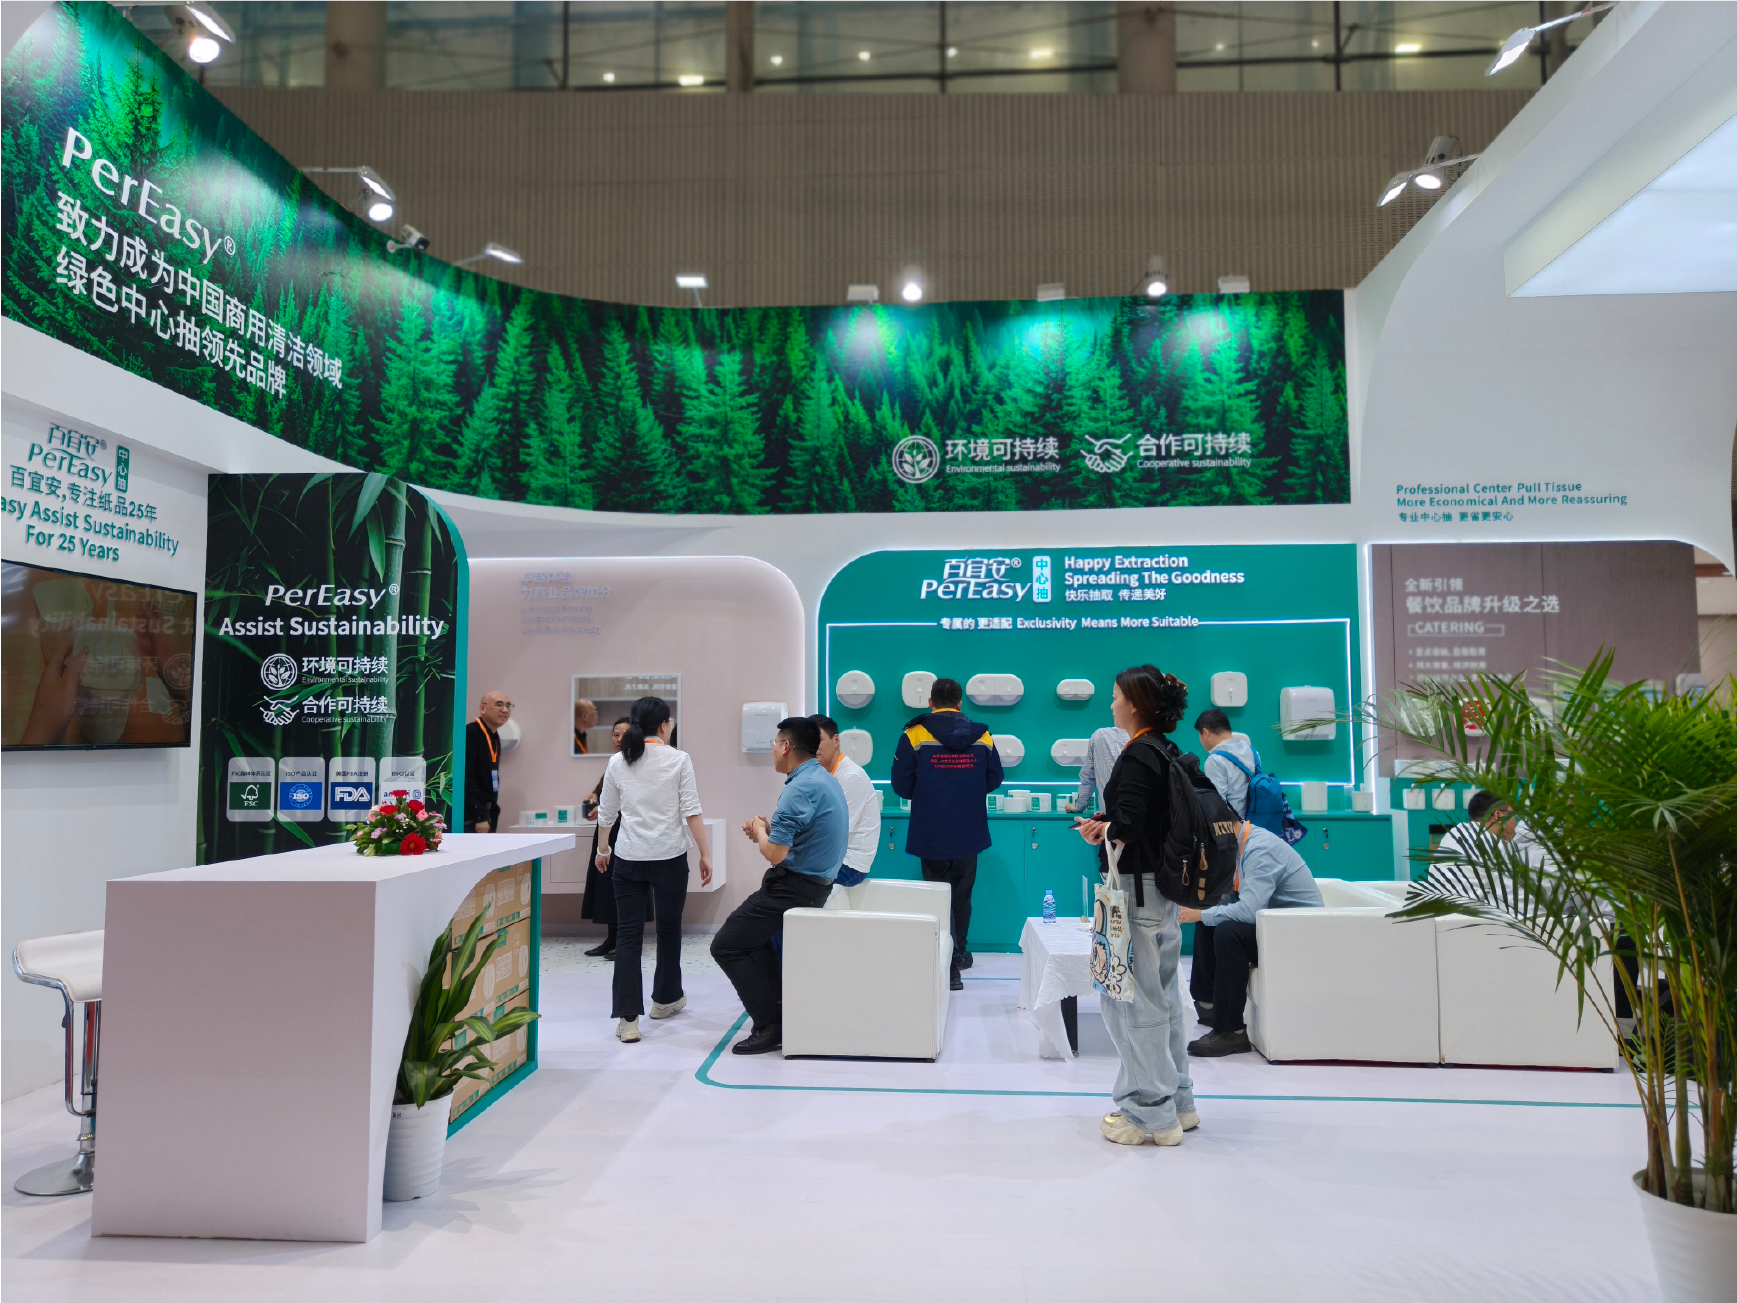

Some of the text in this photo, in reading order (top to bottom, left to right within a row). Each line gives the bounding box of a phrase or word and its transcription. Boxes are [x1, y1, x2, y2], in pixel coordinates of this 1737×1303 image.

[56, 191, 343, 390] 致力成为中国商用清洁领域
[56, 246, 287, 399] 绿色中心抽领先品牌
[945, 436, 1060, 461] 环境可持续
[1137, 432, 1251, 456] 合作可持续
[28, 442, 113, 486] PerEasy
[117, 448, 129, 491] 中心抽
[946, 462, 1061, 474] Environmental sustainability
[1137, 457, 1252, 470] Cooperative sustainability
[1396, 482, 1582, 495] Professional Center Pull Tissue
[1397, 493, 1628, 507] More Economical And More Reassuring
[1399, 511, 1514, 523] 专业中心抽 更省更安心
[31, 501, 79, 529] Assist
[84, 514, 180, 556] Sustainability
[26, 524, 119, 562] For 25 Years
[1065, 555, 1188, 572] Happy Extraction
[1035, 558, 1049, 600] 中心抽
[1065, 570, 1245, 588] Spreading The Goodness
[1404, 578, 1463, 592] 全新引领
[520, 586, 611, 599] 为商业品牌加分
[919, 578, 1032, 602] PerEasy
[1065, 588, 1166, 602] 快乐抽取 传递美好
[1406, 595, 1560, 614] 餐饮品牌升级之选
[219, 616, 284, 636] Assist
[290, 615, 444, 640] Sustainability
[940, 615, 1199, 631] 专属的 更适配 Exclusivity Means More Suitable
[1415, 622, 1485, 634] CATERING
[302, 656, 389, 675] 环境可持续
[302, 676, 389, 684] Environmental sustainability
[302, 696, 388, 714] 合作可持续
[302, 715, 388, 724] Cooperative sustainability
[292, 792, 310, 800] ISO
[335, 787, 371, 802] FDA
